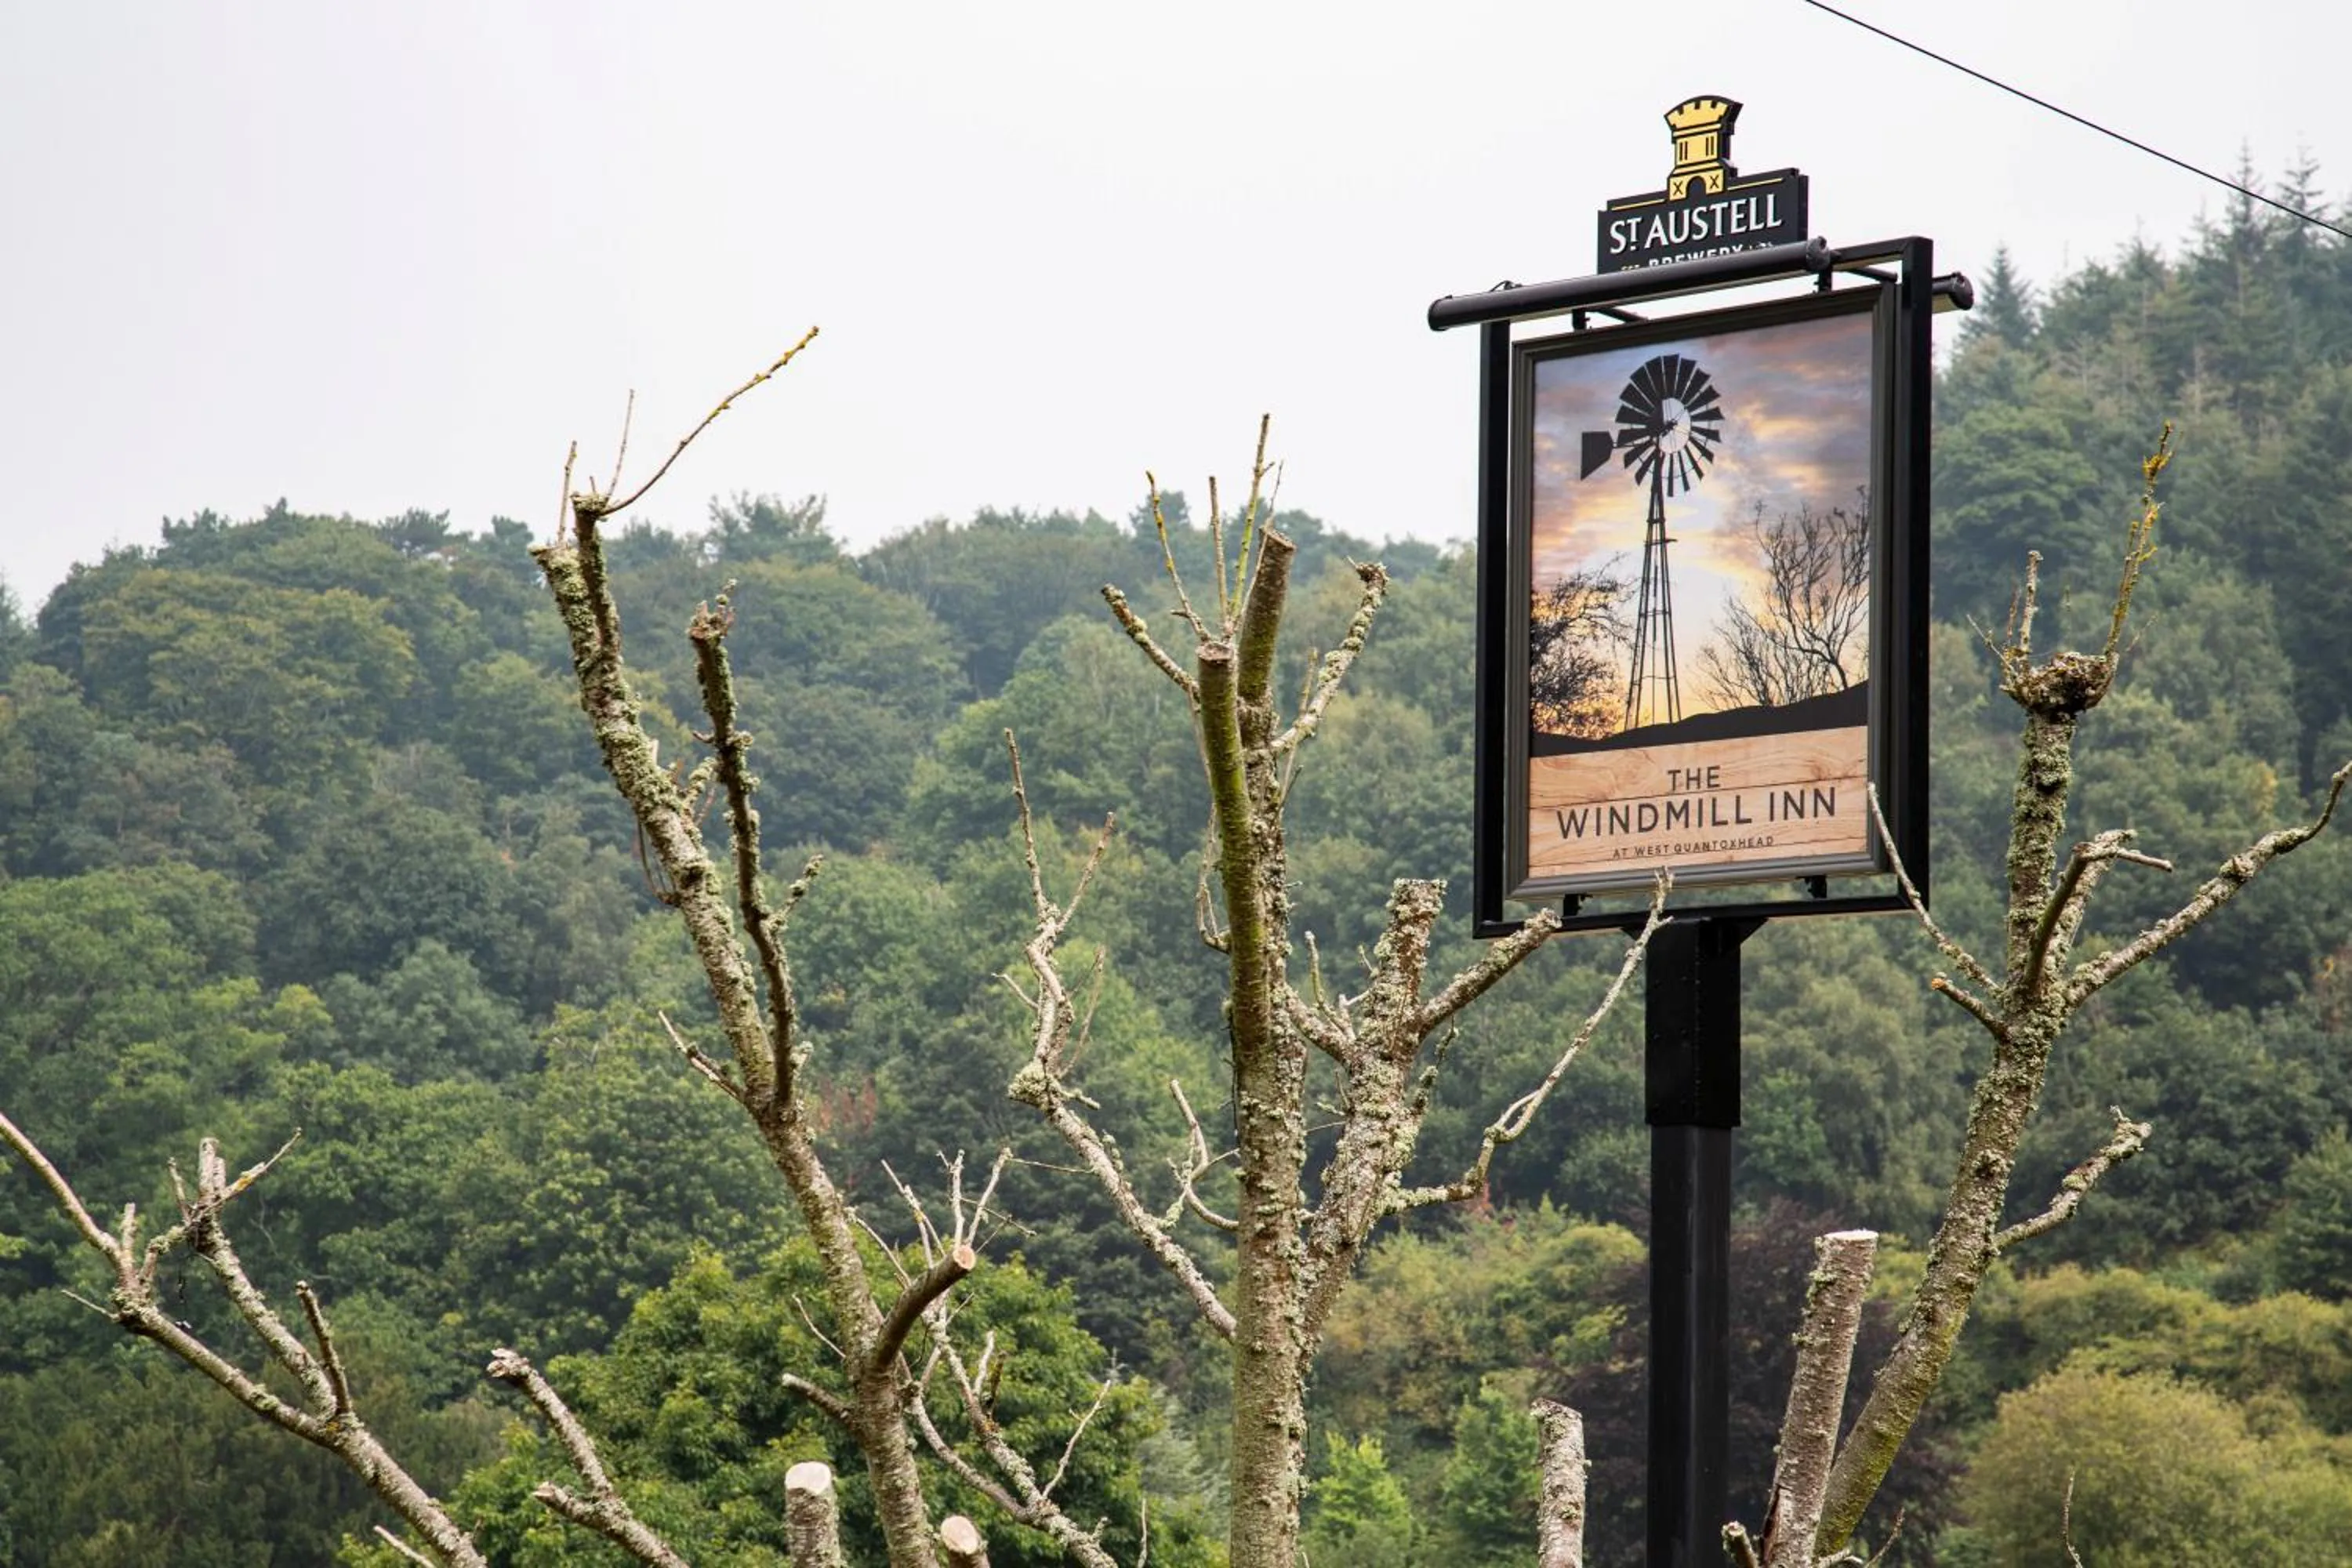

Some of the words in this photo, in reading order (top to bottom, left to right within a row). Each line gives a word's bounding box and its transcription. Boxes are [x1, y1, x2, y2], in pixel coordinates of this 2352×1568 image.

[1644, 194, 1782, 249] AUSTELL
[1668, 764, 1721, 792] THE
[1556, 794, 1752, 840] WINDMILL
[1769, 786, 1835, 822] INN
[1613, 848, 1628, 859] AT
[1635, 844, 1669, 856] WEST
[1674, 836, 1774, 853] QUANTOXHEAD
